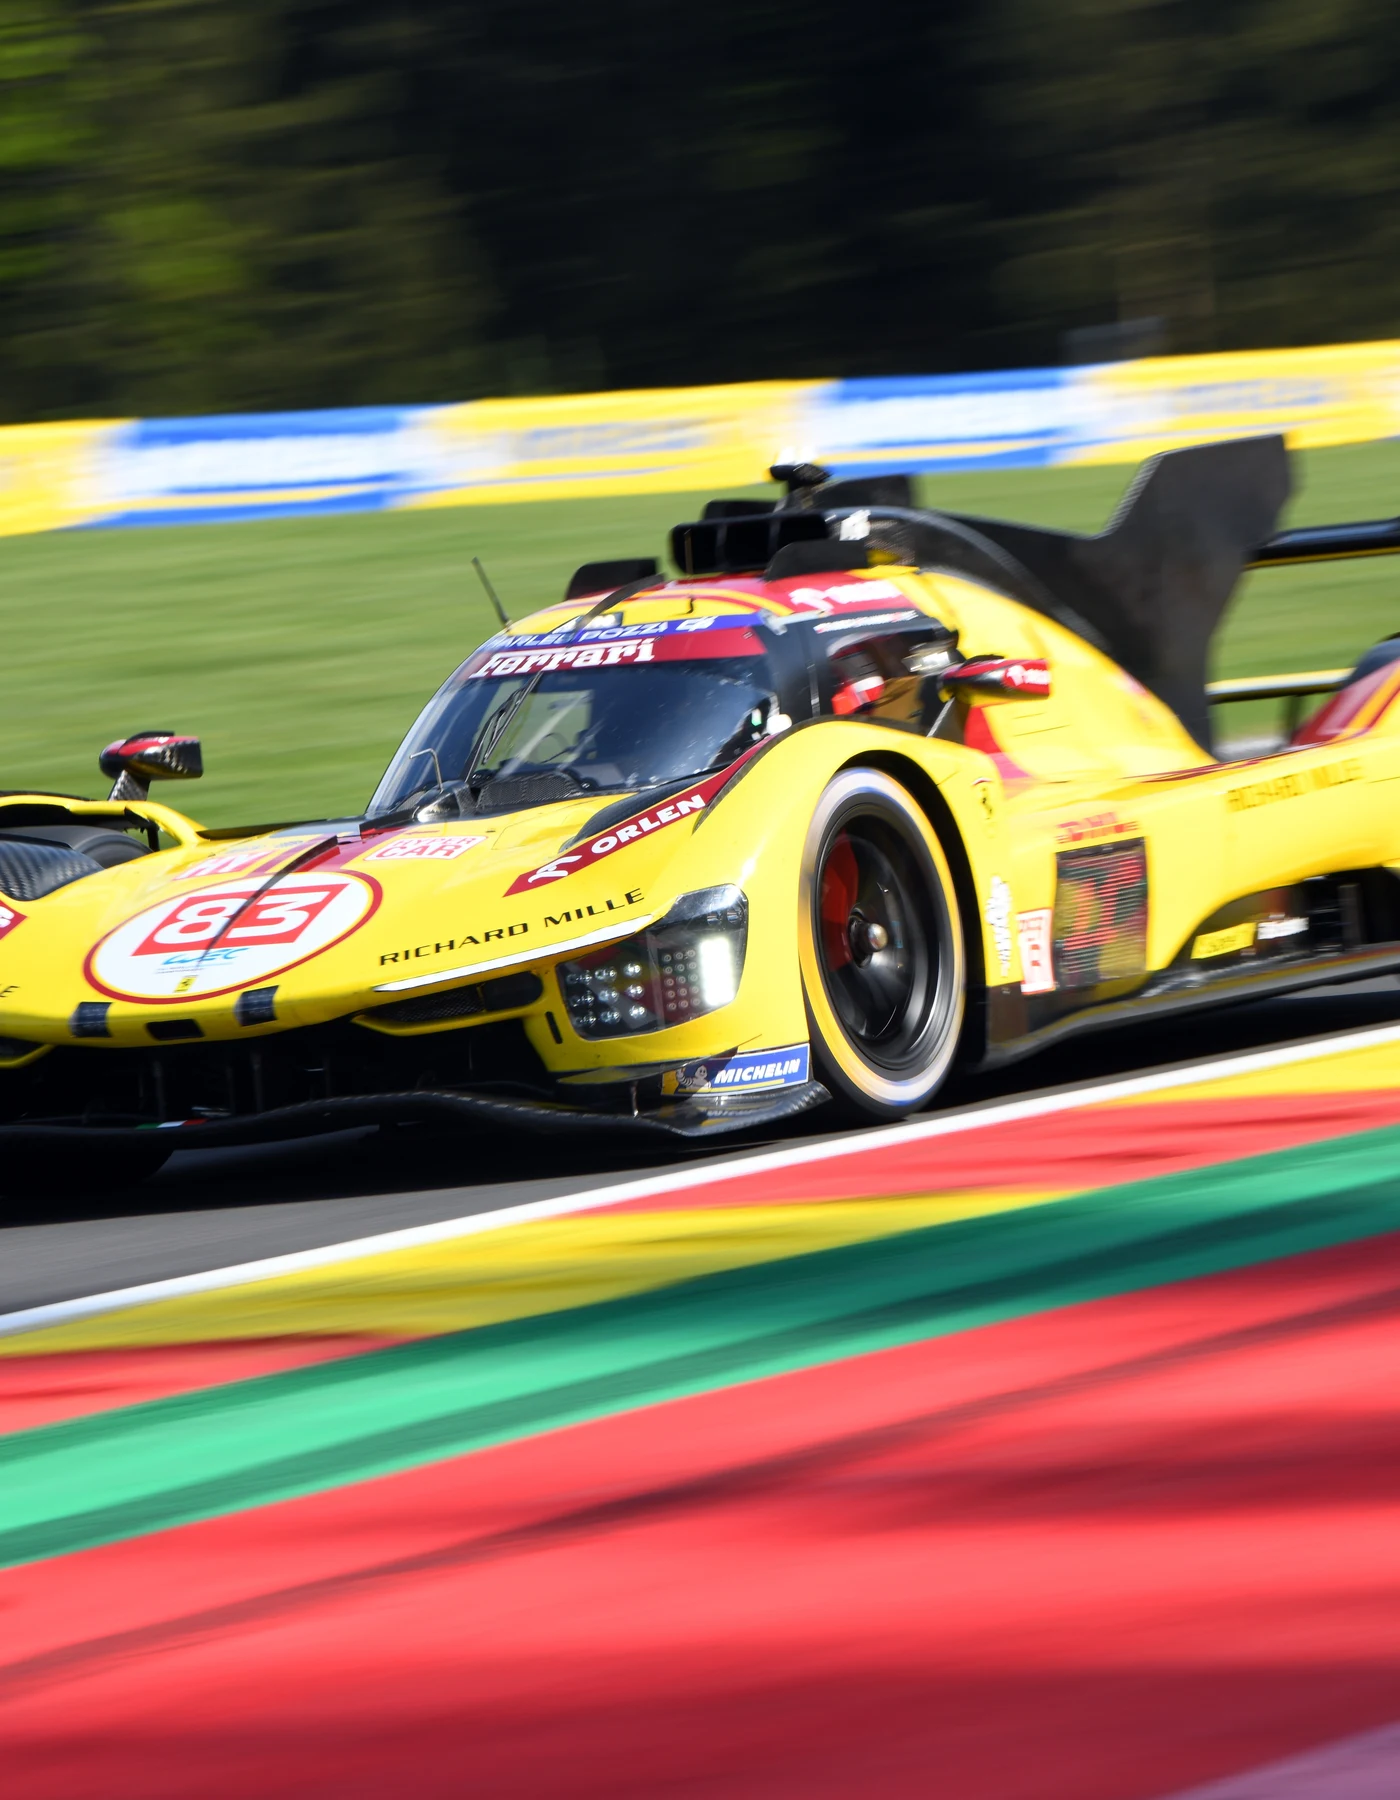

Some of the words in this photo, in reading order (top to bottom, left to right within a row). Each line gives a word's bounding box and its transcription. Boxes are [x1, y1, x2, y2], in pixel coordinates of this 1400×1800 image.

[578, 621, 668, 642] POZZI
[469, 638, 656, 678] Ferrari
[590, 794, 706, 855] ORLEN
[375, 845, 463, 858] CAR
[391, 837, 478, 847] HYPER
[153, 890, 332, 945] 83
[379, 922, 529, 966] RICHARD
[543, 887, 645, 928] MILLE
[714, 1058, 801, 1084] MICHELIN
